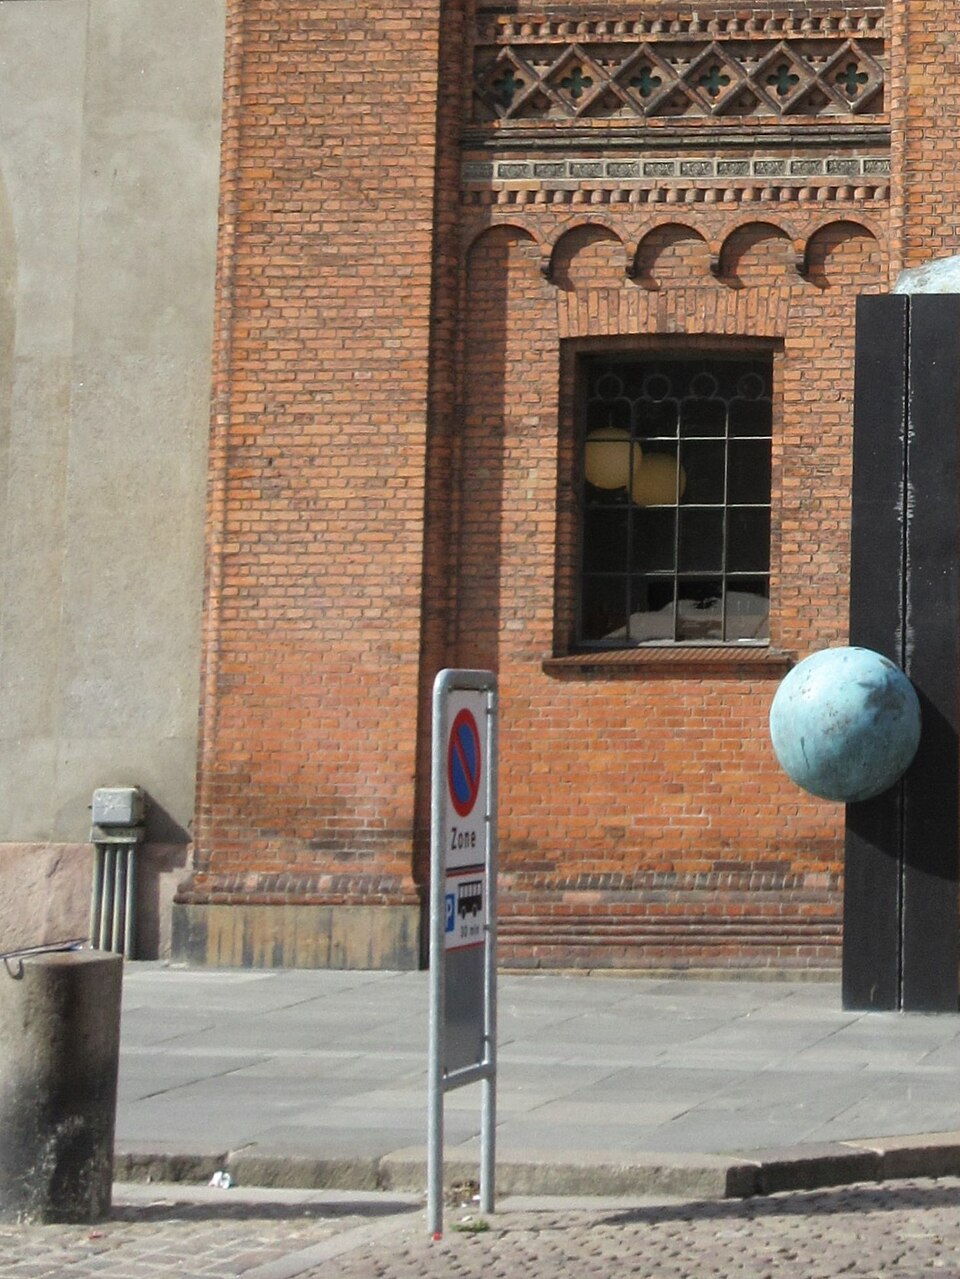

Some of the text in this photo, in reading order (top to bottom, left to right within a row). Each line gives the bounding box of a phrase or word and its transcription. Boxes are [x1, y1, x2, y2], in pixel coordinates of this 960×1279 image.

[451, 827, 476, 850] Zone
[445, 898, 453, 930] P
[470, 924, 480, 936] min
